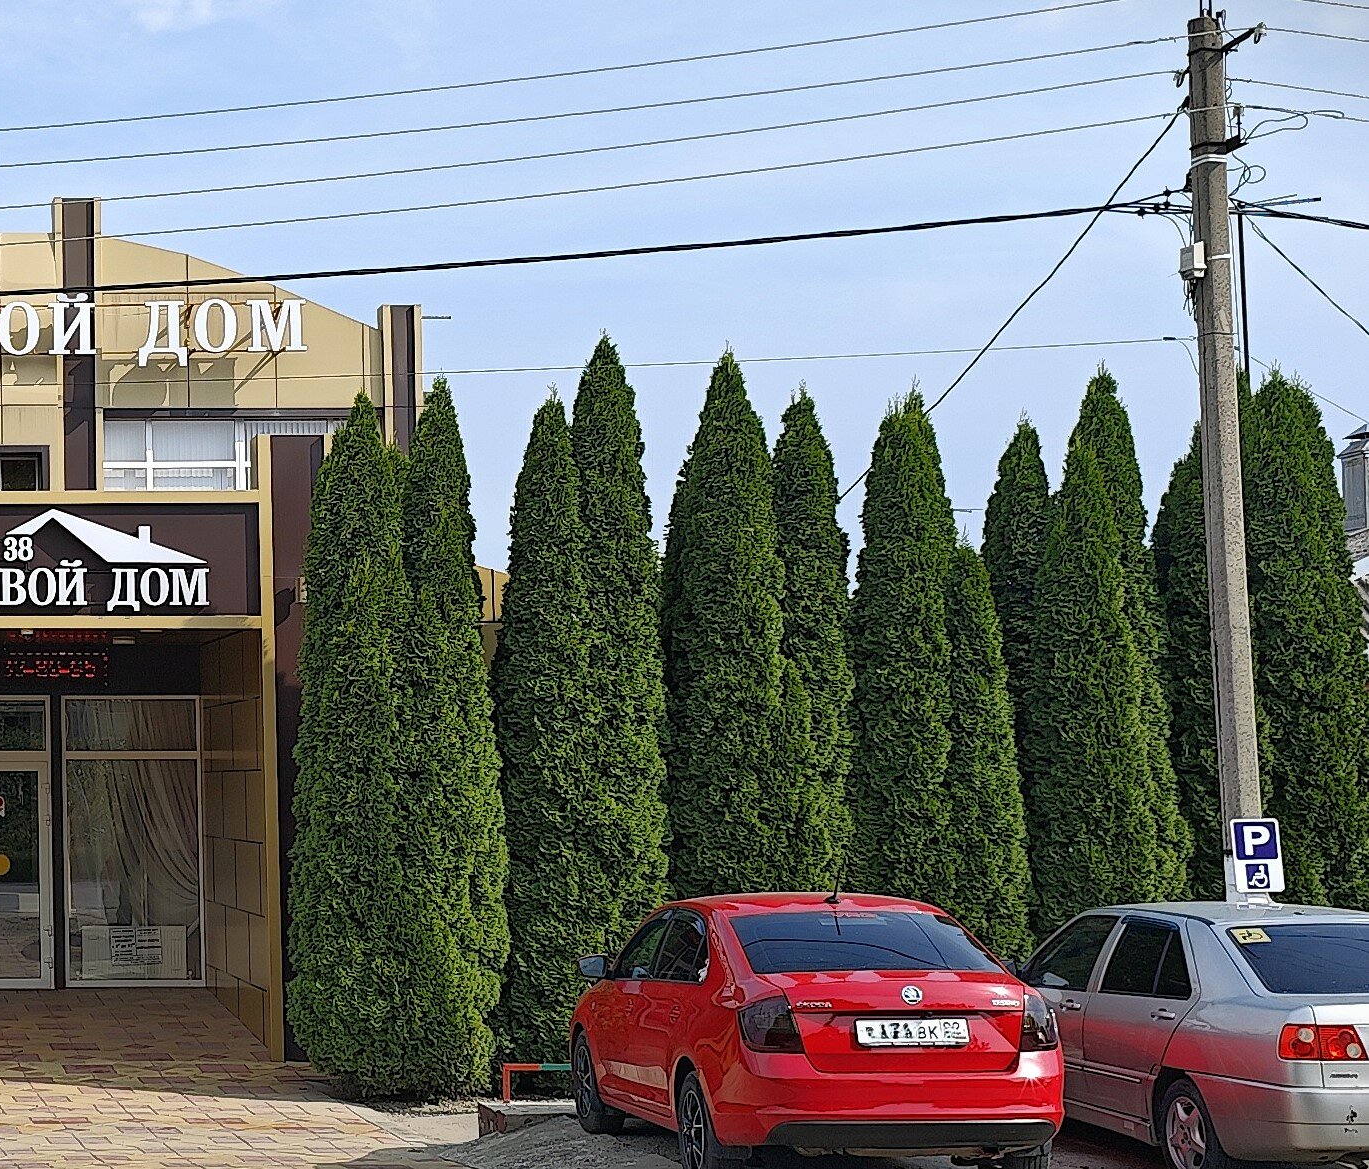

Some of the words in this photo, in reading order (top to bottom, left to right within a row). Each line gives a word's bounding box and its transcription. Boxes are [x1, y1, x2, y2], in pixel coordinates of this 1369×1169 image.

[138, 299, 308, 367] ДОМ
[3, 536, 34, 562] 38
[106, 567, 210, 612] ДОМ
[1242, 825, 1270, 855] P
